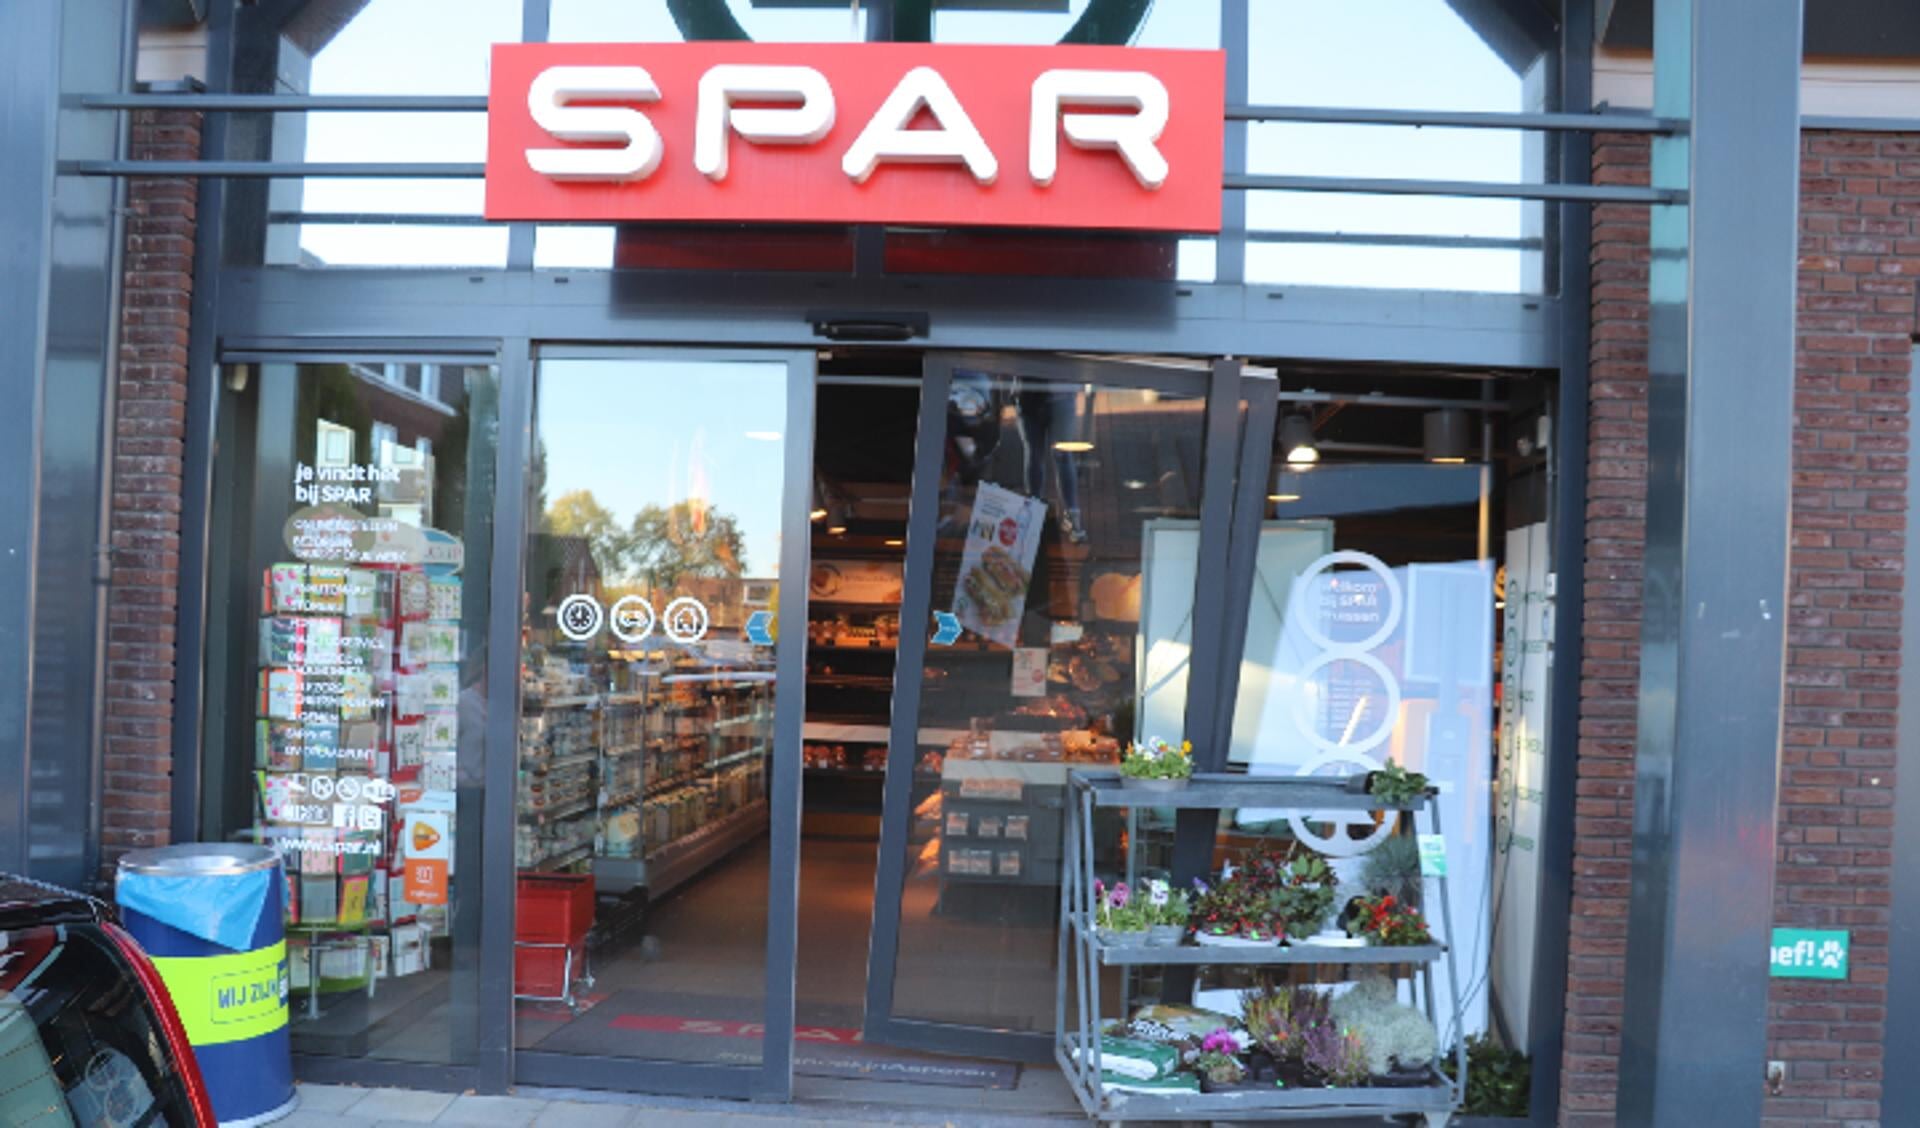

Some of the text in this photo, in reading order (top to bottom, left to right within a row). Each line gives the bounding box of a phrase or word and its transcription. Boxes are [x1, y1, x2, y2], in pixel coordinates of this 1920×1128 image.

[525, 65, 1170, 191] SPAR
[294, 461, 313, 483] je
[318, 463, 366, 481] vindt
[295, 484, 371, 507] bij SPAR
[218, 985, 247, 1009] WIJ
